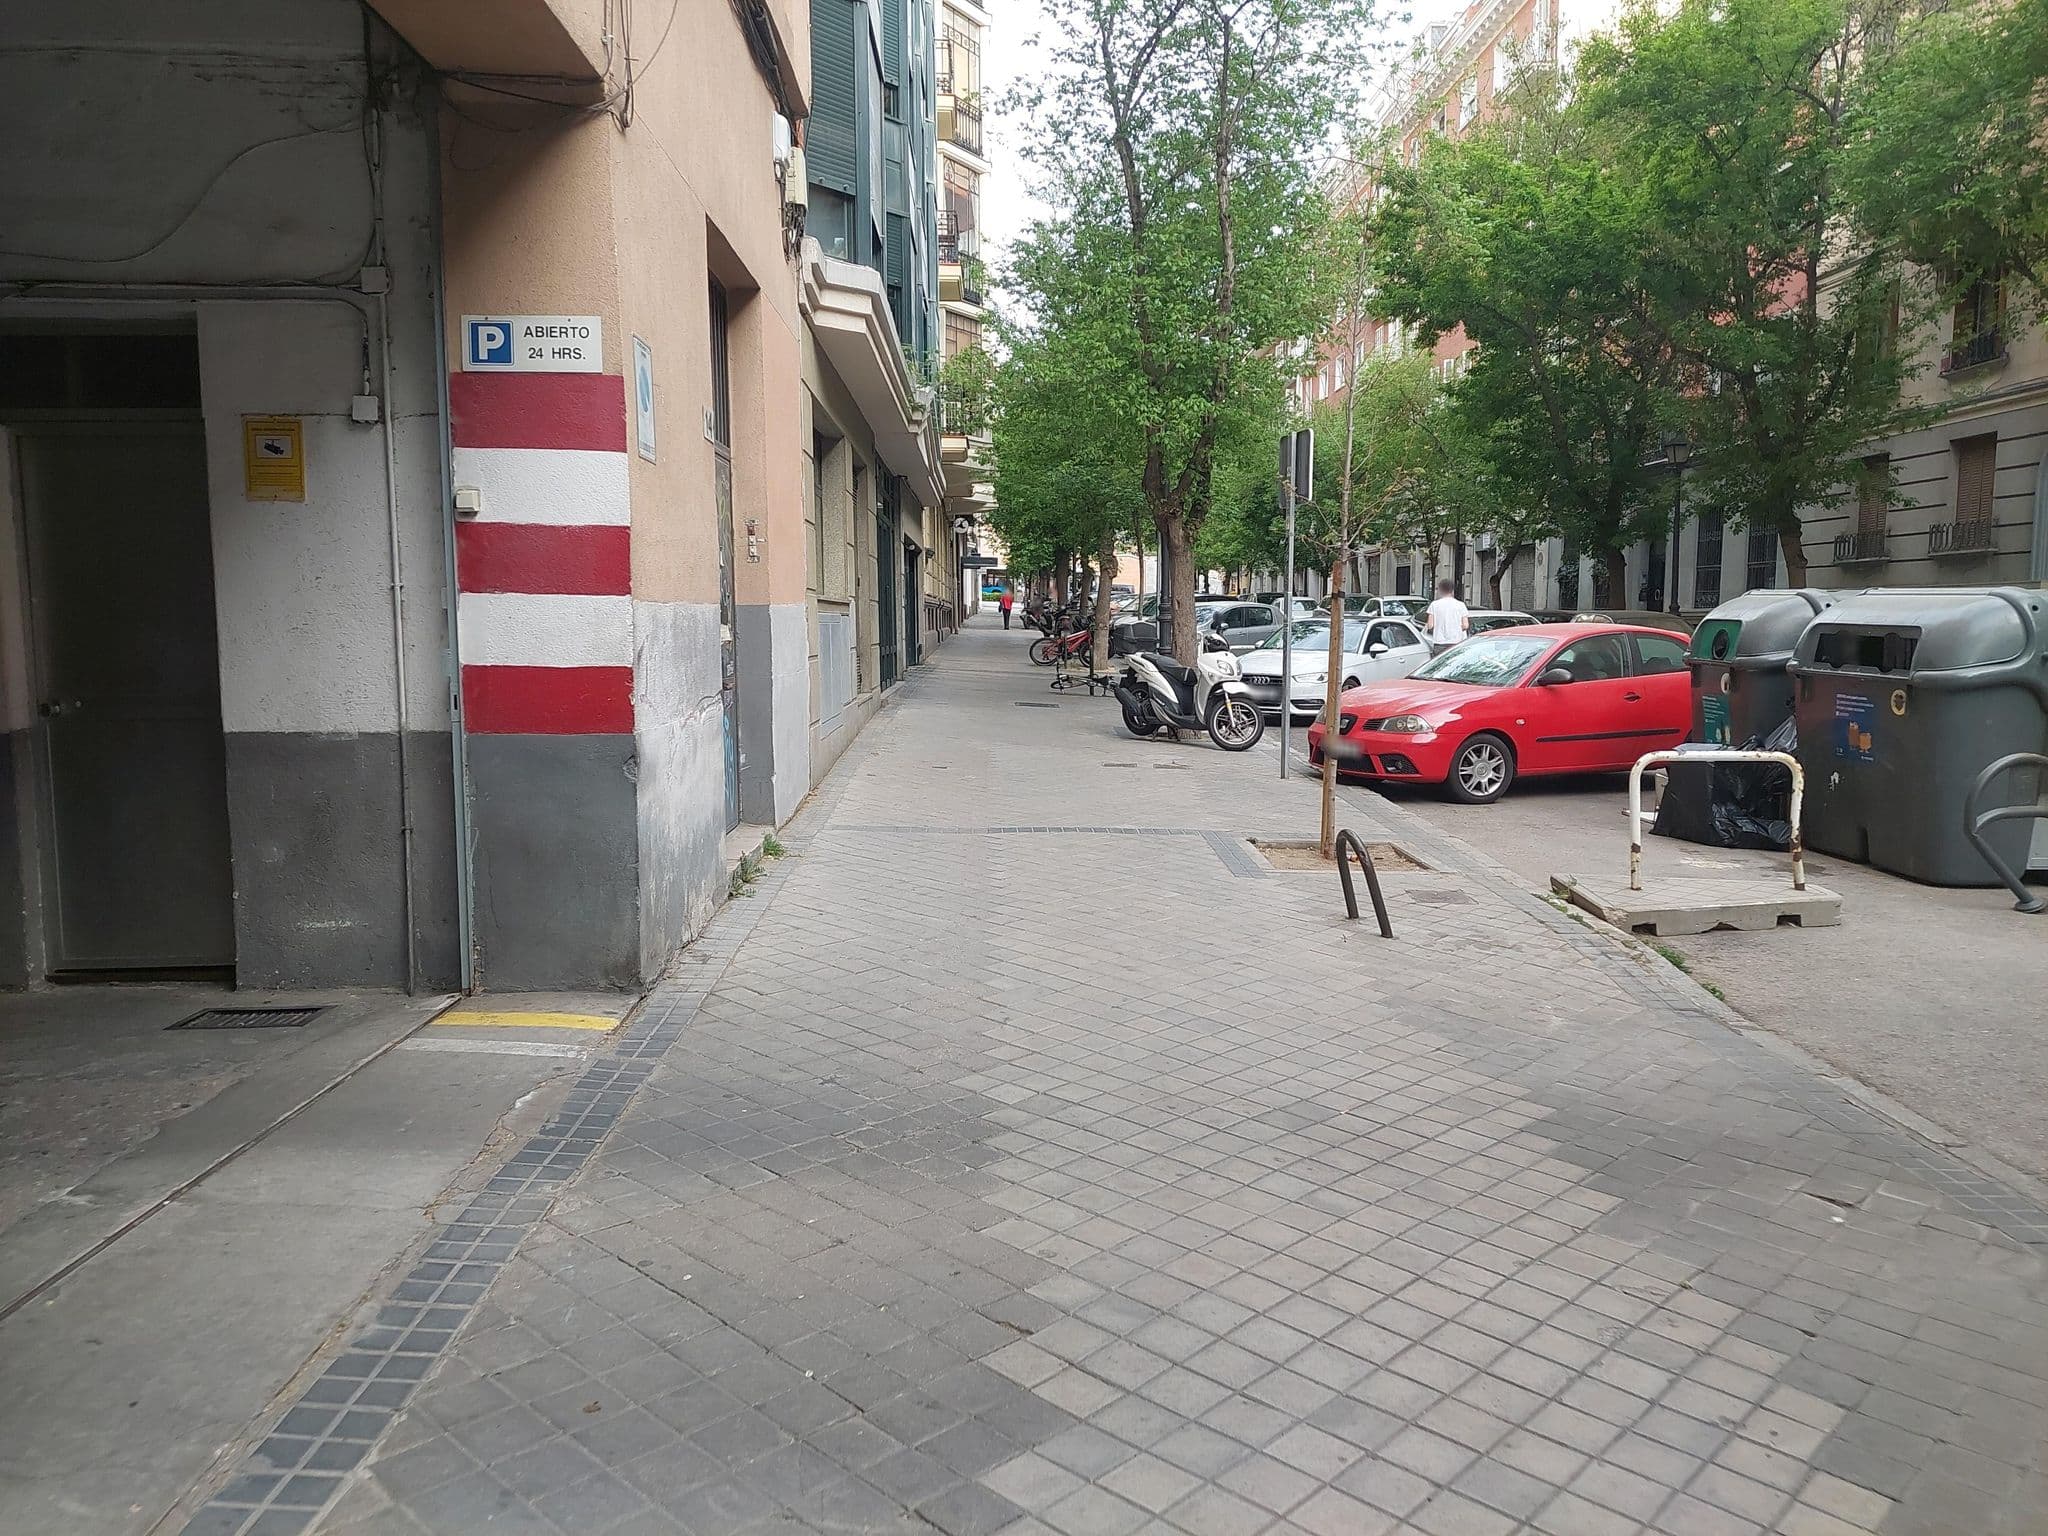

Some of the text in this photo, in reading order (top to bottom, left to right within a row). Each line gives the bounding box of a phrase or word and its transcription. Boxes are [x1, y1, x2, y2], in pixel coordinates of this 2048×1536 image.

[523, 326, 590, 339] ABIERTO
[477, 325, 505, 360] P
[528, 347, 586, 360] 24 HRS.
